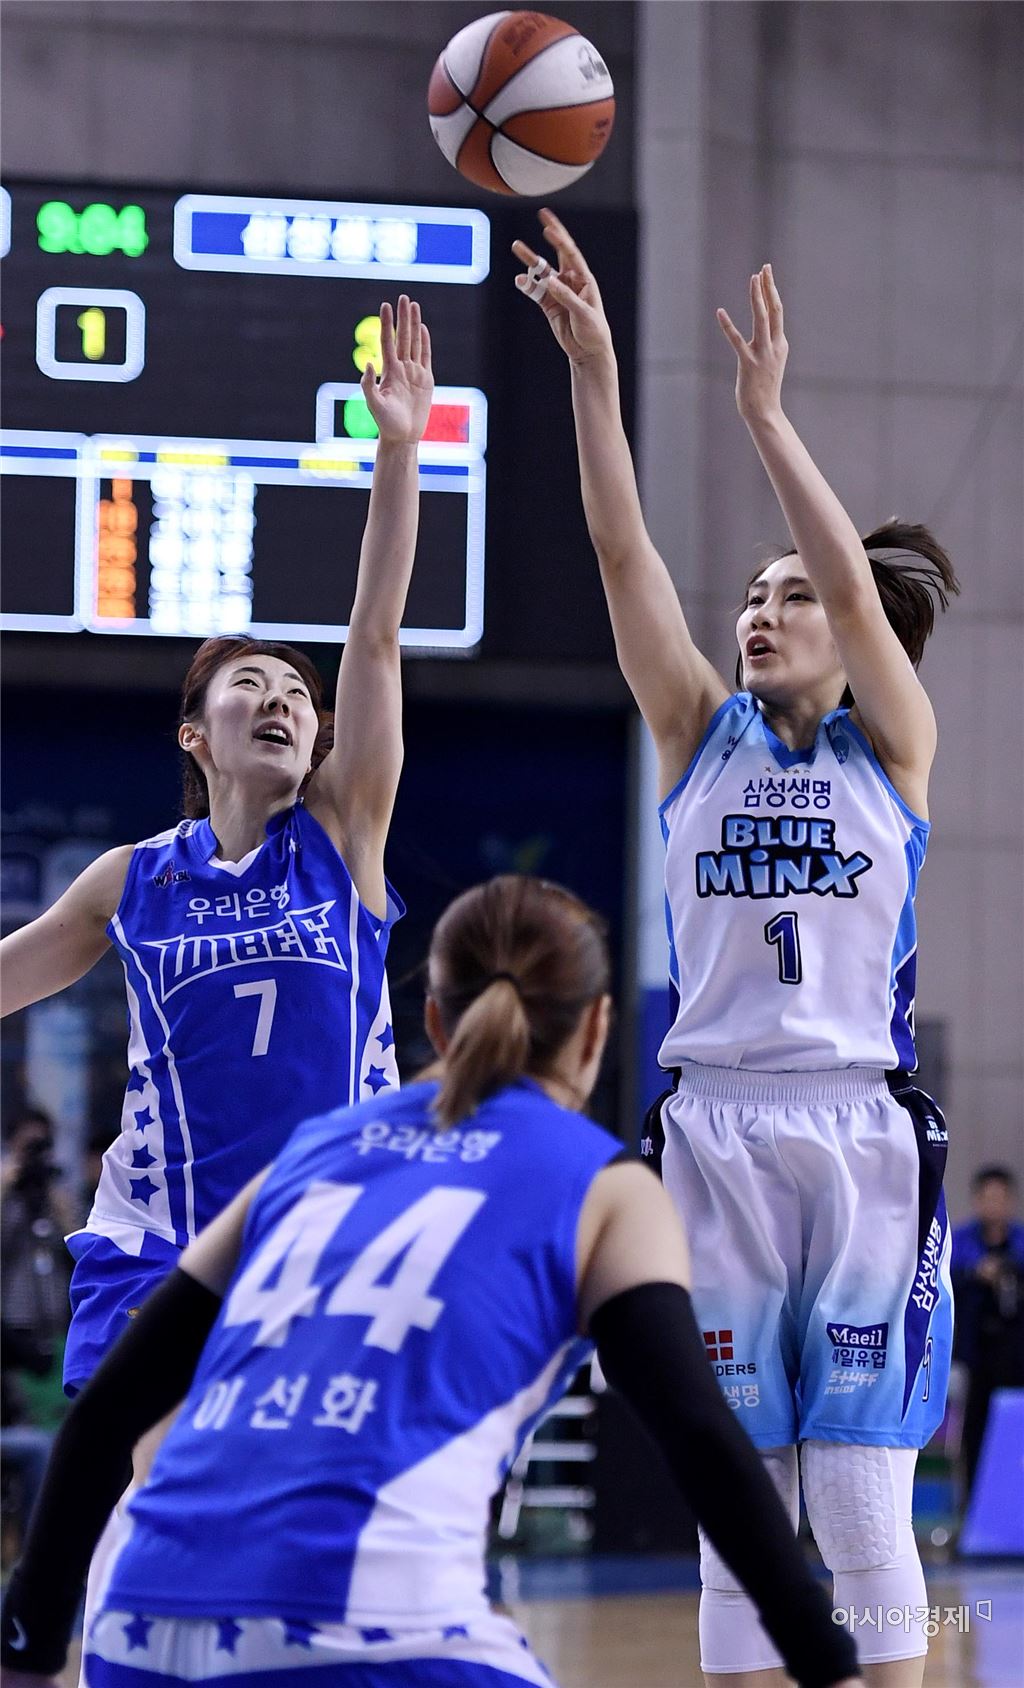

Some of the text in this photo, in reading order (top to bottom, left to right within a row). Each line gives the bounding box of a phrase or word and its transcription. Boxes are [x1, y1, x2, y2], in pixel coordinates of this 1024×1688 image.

[77, 307, 106, 361] 1
[743, 777, 832, 810] 삼성생명
[722, 814, 836, 850] BLUE
[764, 911, 802, 984] 1
[233, 978, 278, 1057] 7
[223, 1180, 488, 1355] 44
[831, 1327, 882, 1346] Maeil
